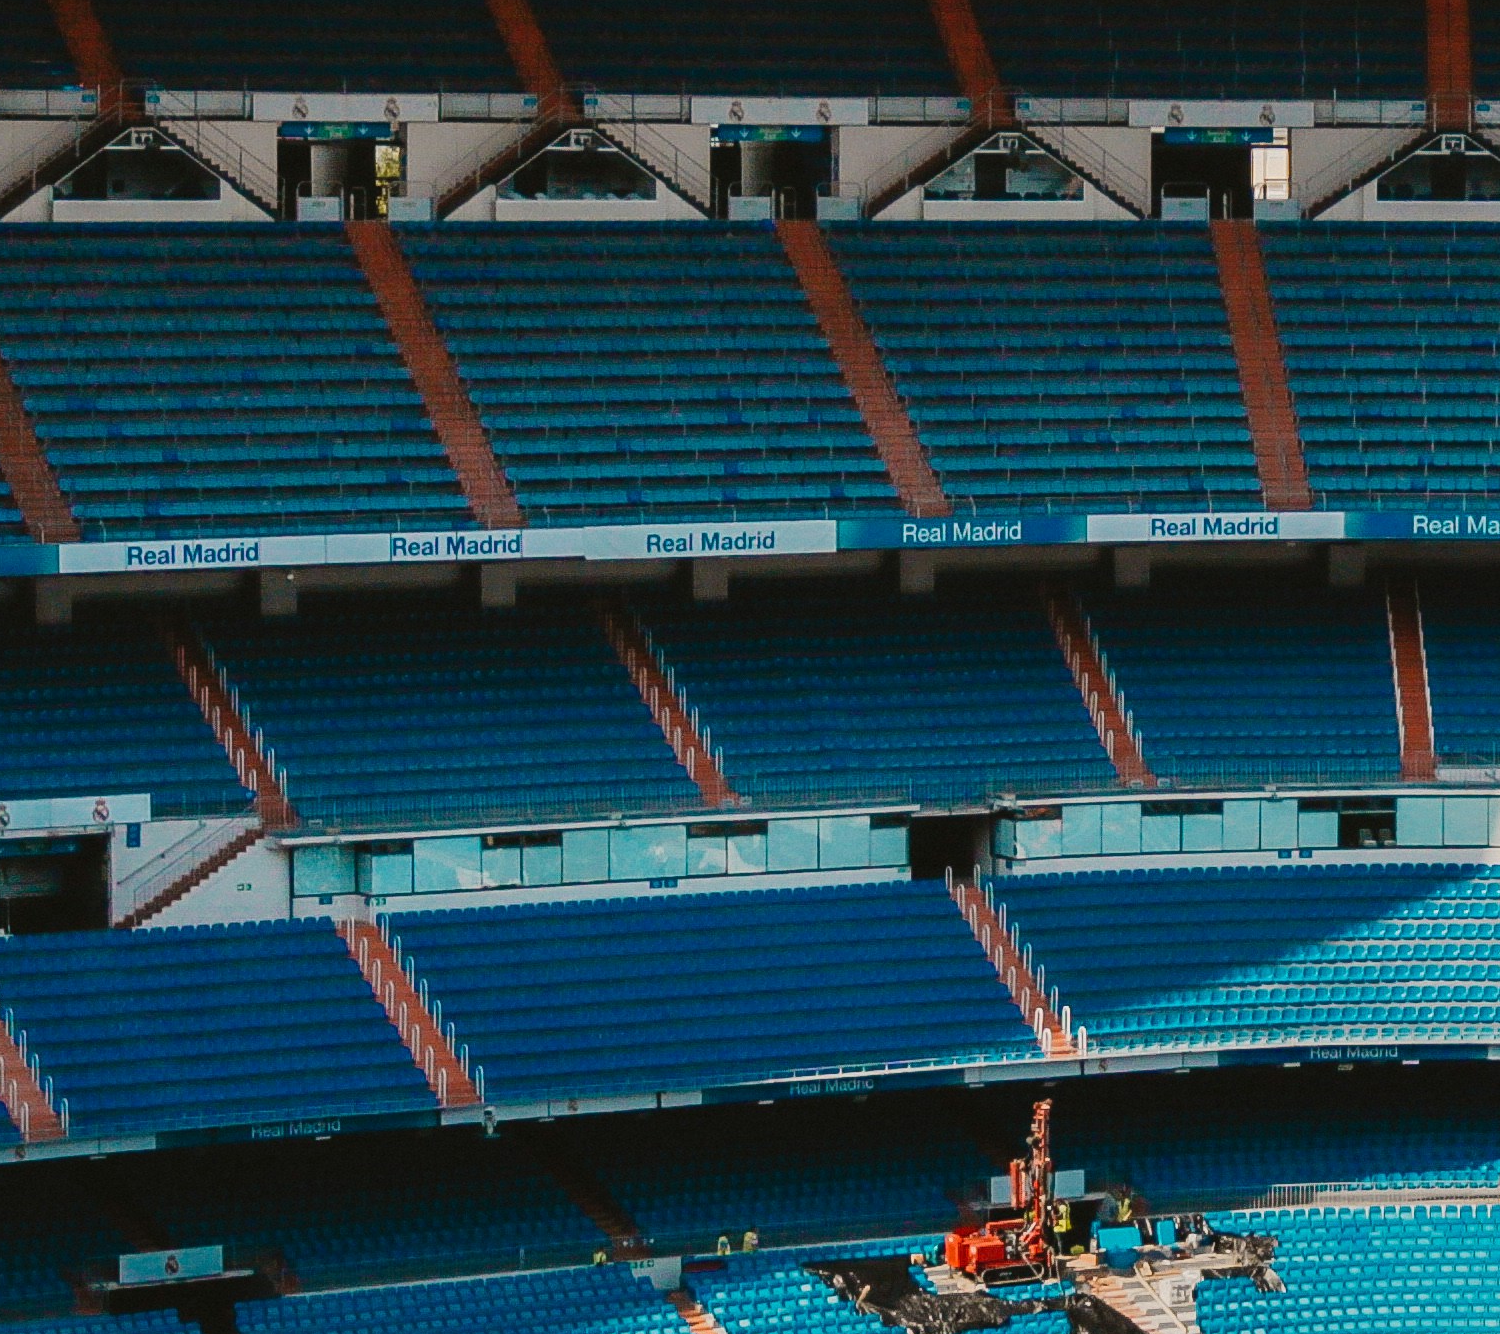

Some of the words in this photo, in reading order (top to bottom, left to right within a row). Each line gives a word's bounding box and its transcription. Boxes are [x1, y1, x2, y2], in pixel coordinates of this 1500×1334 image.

[903, 524, 946, 543] Real
[953, 521, 1021, 541] Madrid
[1151, 518, 1196, 536] Real
[1203, 517, 1277, 536] Madrid
[1413, 516, 1460, 534] Real
[392, 537, 439, 556] Real
[447, 534, 520, 554] Madrid
[647, 533, 692, 552] Real
[701, 531, 775, 551] Madrid
[127, 545, 175, 565] Real
[184, 542, 258, 563] Madrid
